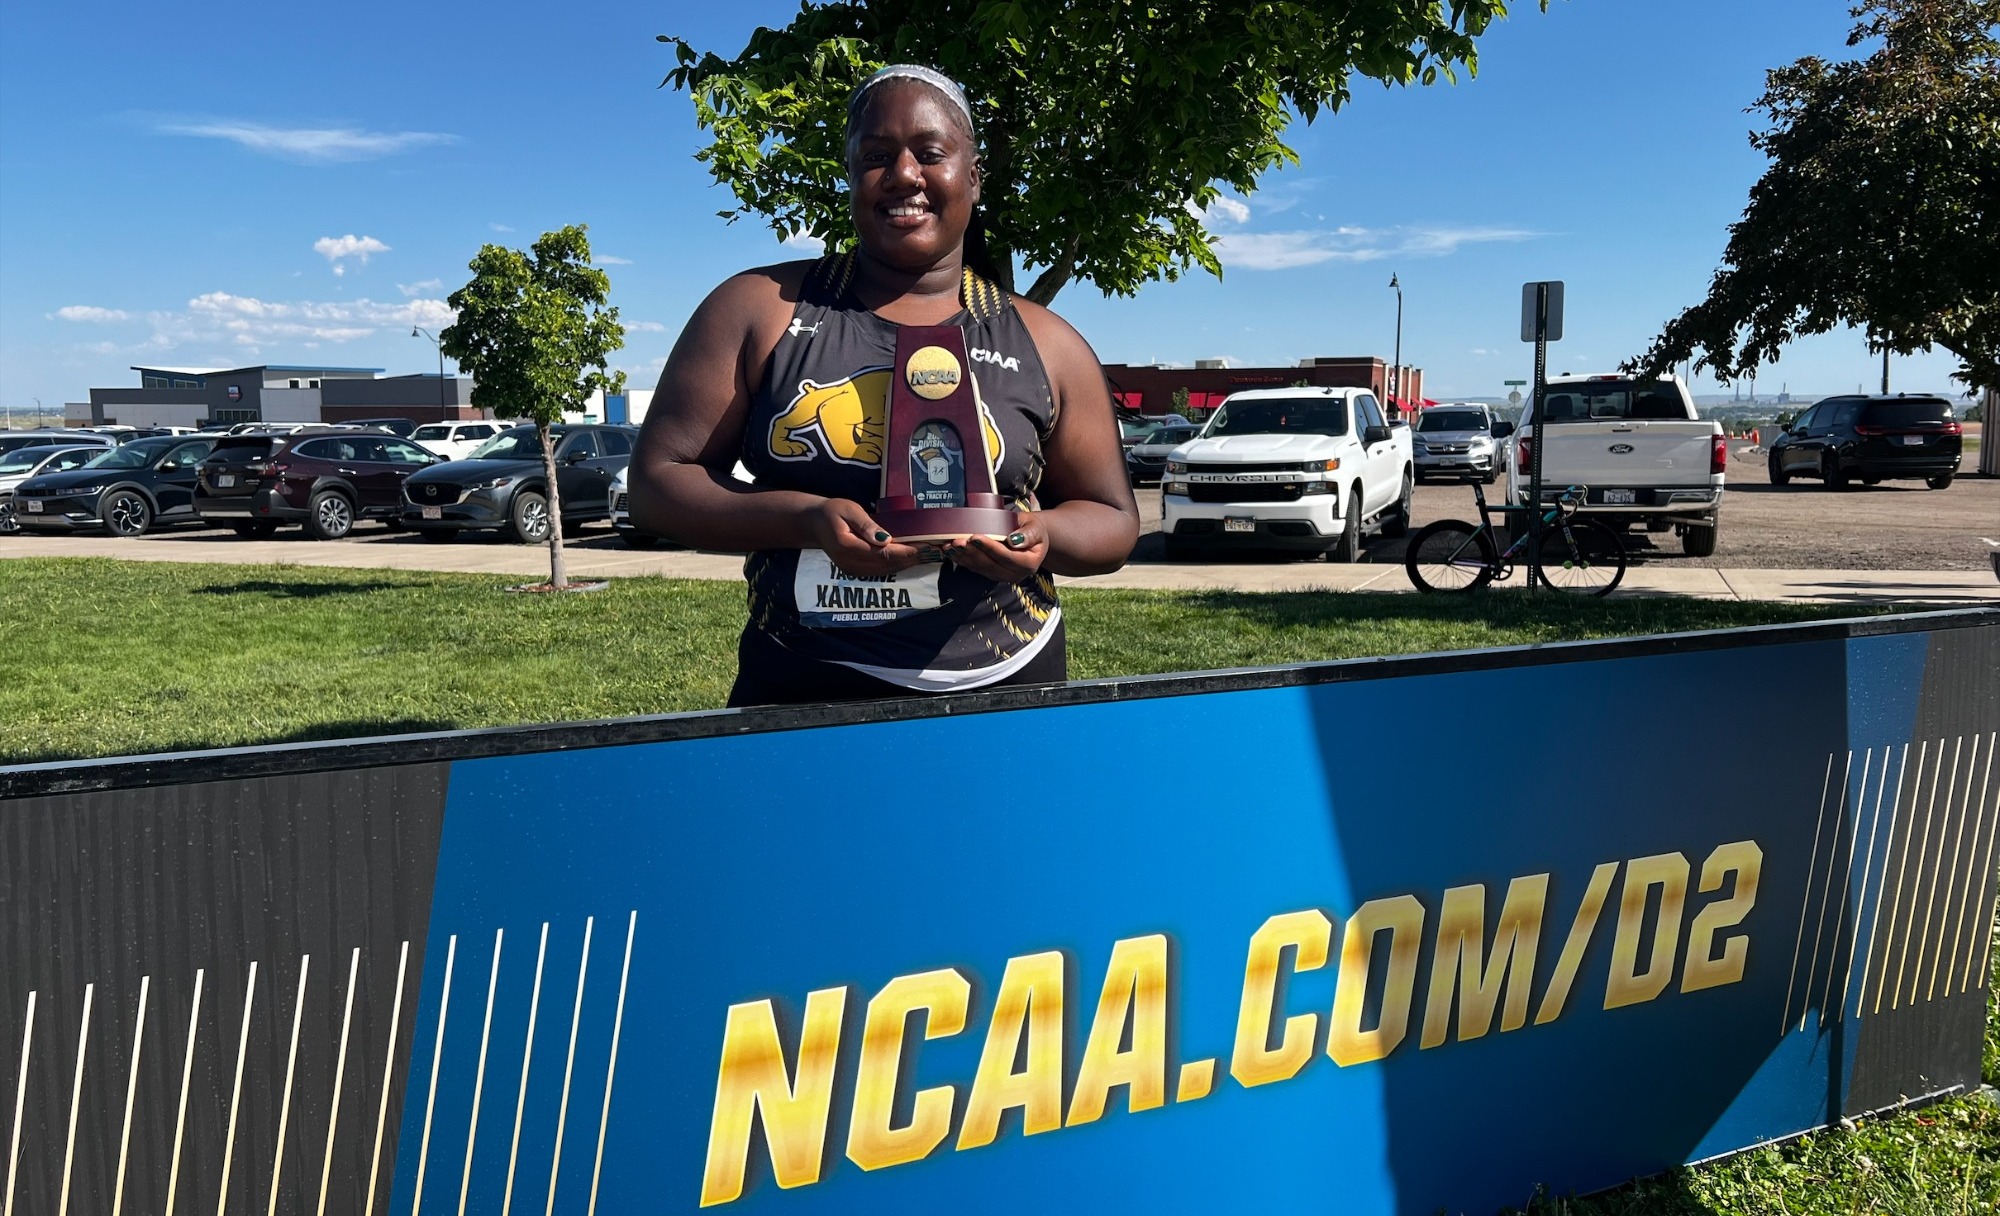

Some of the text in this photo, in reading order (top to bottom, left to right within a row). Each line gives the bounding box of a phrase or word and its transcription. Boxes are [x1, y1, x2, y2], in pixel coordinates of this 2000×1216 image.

[970, 347, 1020, 373] CIAA
[911, 369, 958, 386] NCAA
[832, 612, 897, 622] PUEBLO, COLORADO
[700, 839, 1764, 1208] NCAA.COM/D2
